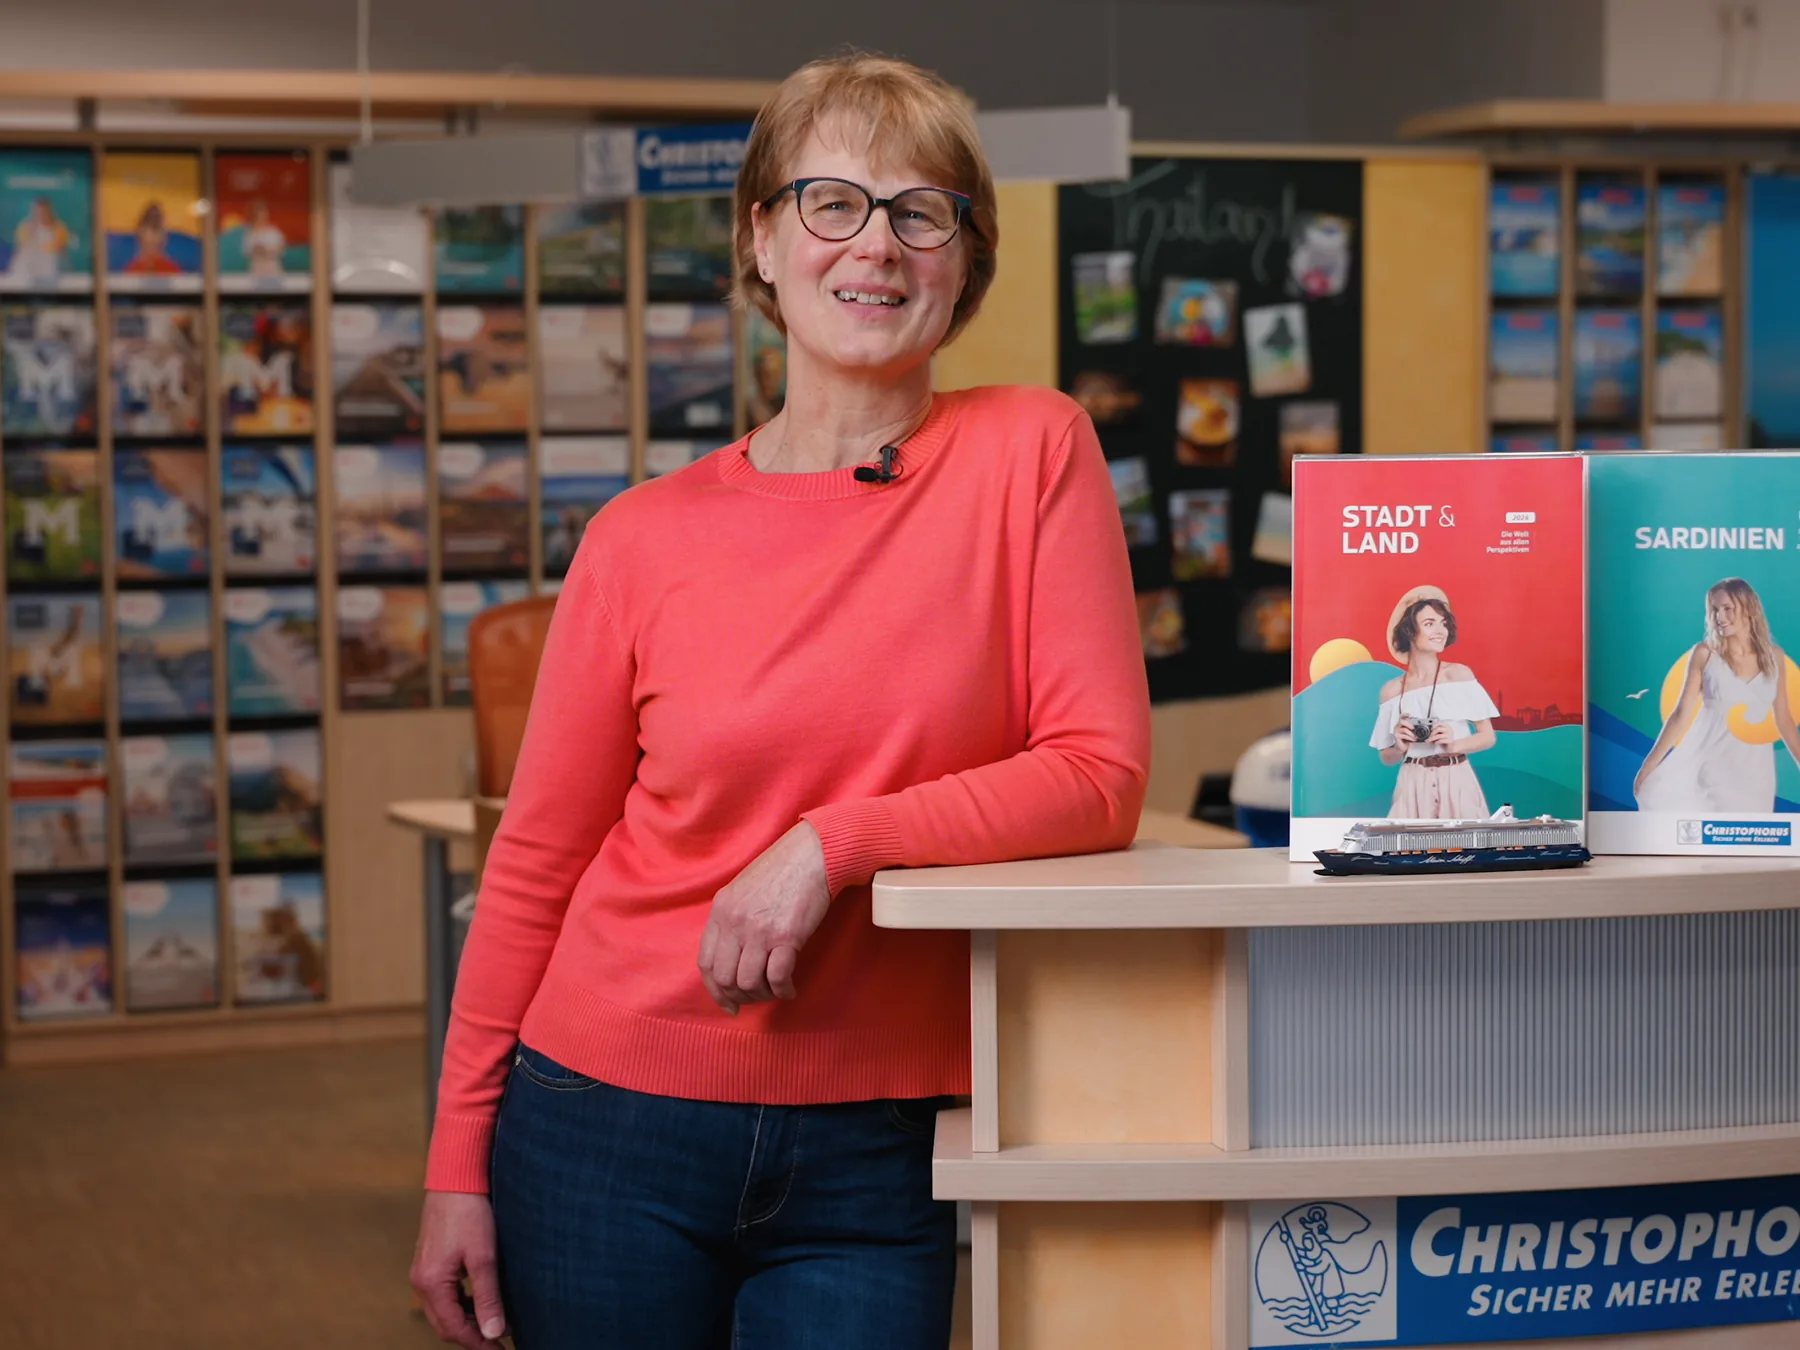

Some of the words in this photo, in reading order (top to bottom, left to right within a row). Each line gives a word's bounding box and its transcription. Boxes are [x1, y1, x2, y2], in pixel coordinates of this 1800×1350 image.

[1342, 505, 1433, 528] STADT
[1438, 505, 1456, 528] &
[1342, 532, 1420, 554] LAND
[1501, 530, 1513, 538] Die
[1513, 530, 1530, 538] Welt
[1635, 526, 1785, 550] SARDINIEN
[1486, 546, 1530, 554] Perspektiven
[1703, 823, 1789, 836] CHRISTOPHORUS
[1410, 1206, 1800, 1277] CHRISTOPHO
[1466, 1284, 1593, 1317] SICHER
[1604, 1276, 1702, 1308] MEHR
